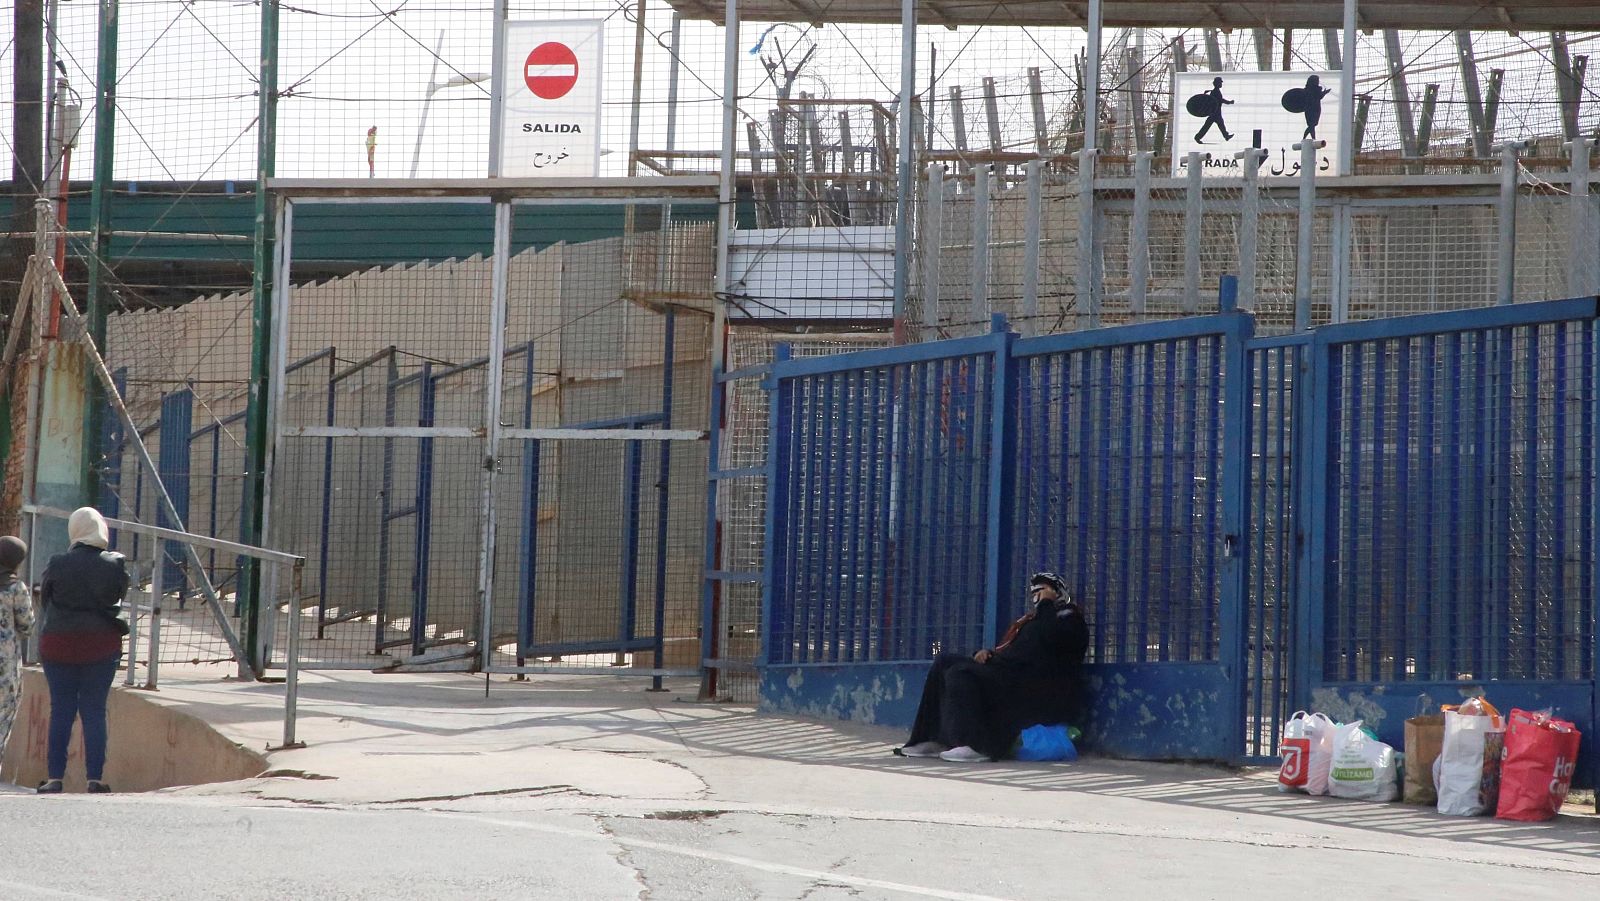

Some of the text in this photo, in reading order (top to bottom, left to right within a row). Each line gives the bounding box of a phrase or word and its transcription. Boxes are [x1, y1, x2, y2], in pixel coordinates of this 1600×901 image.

[522, 123, 581, 133] SALIDA
[1180, 158, 1238, 168] ERADA
[1271, 147, 1329, 176] دول
